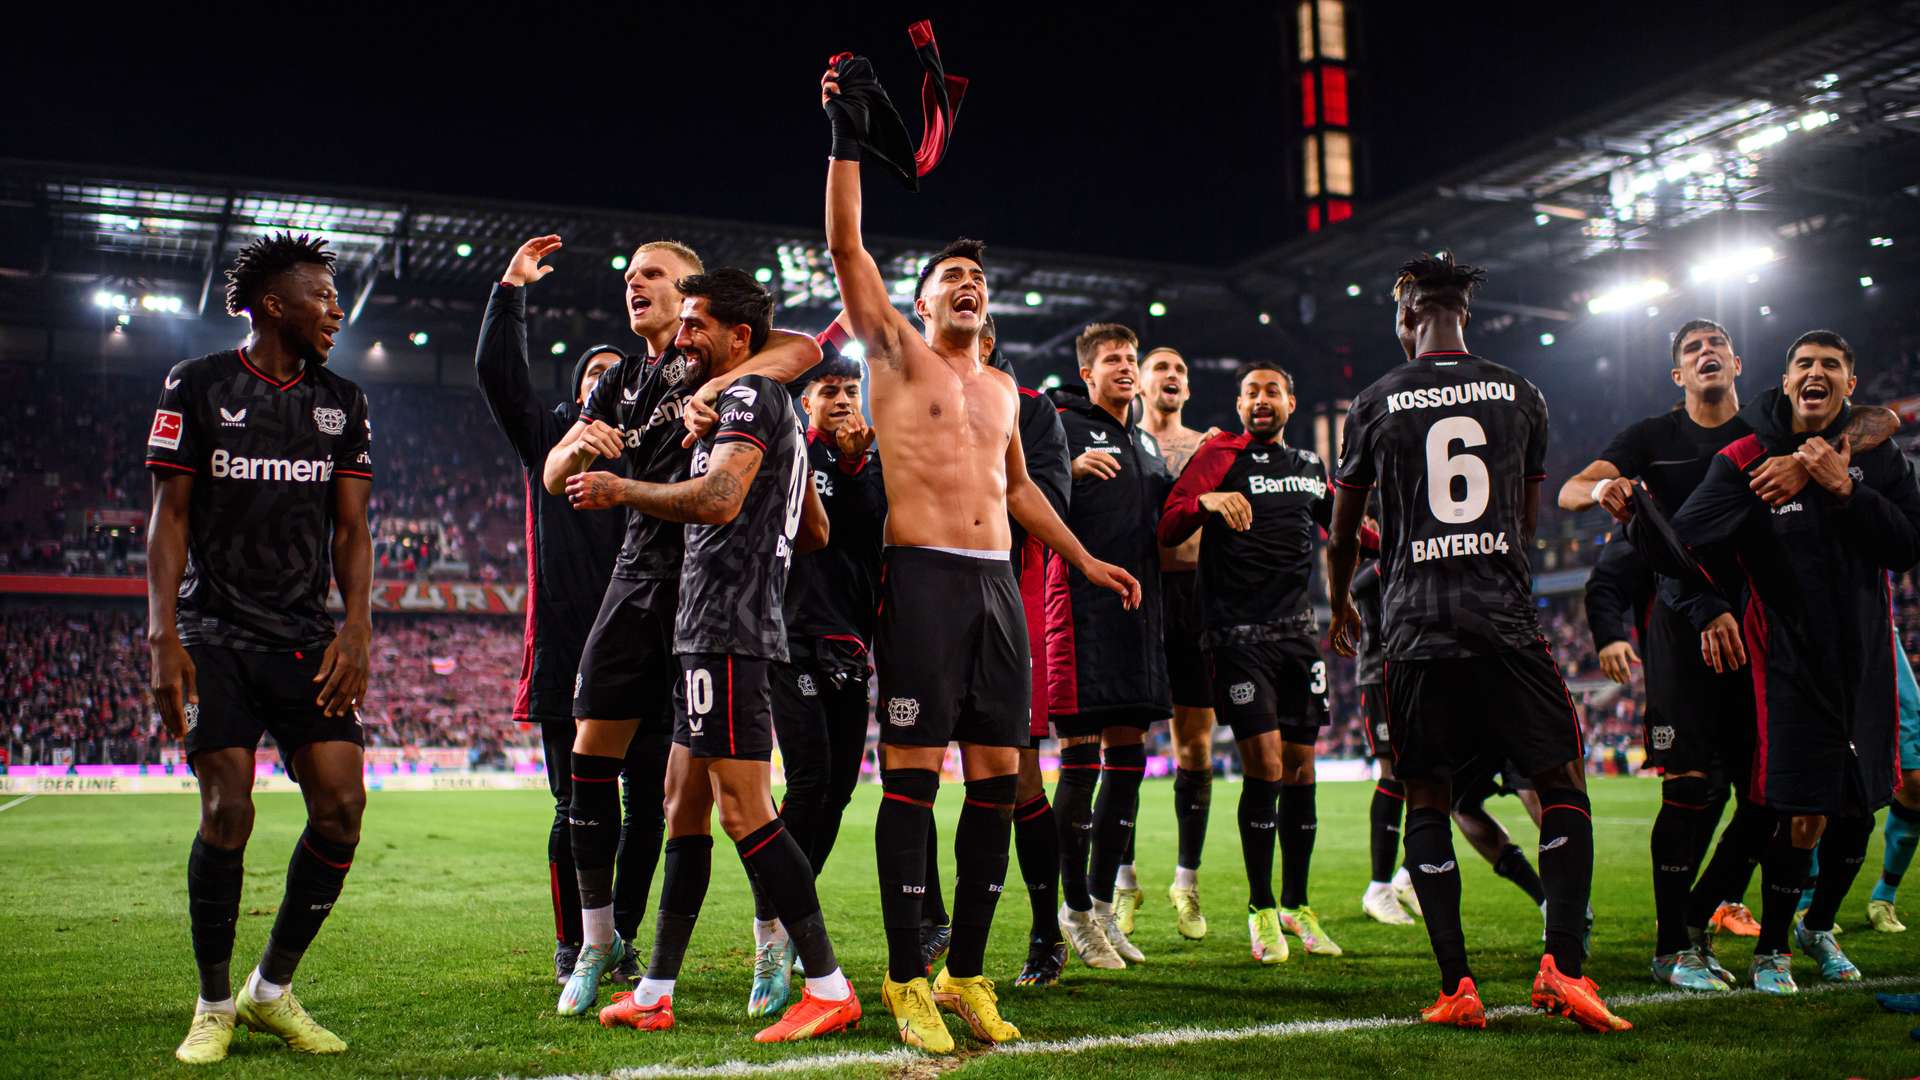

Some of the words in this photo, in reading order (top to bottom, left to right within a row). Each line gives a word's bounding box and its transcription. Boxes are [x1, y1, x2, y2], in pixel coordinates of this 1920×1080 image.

[1386, 381, 1516, 414] KOSSOUNOU
[1426, 416, 1490, 524] 6
[1248, 475, 1327, 499] Barmenia
[685, 668, 714, 715] 10
[1311, 661, 1327, 694] 3
